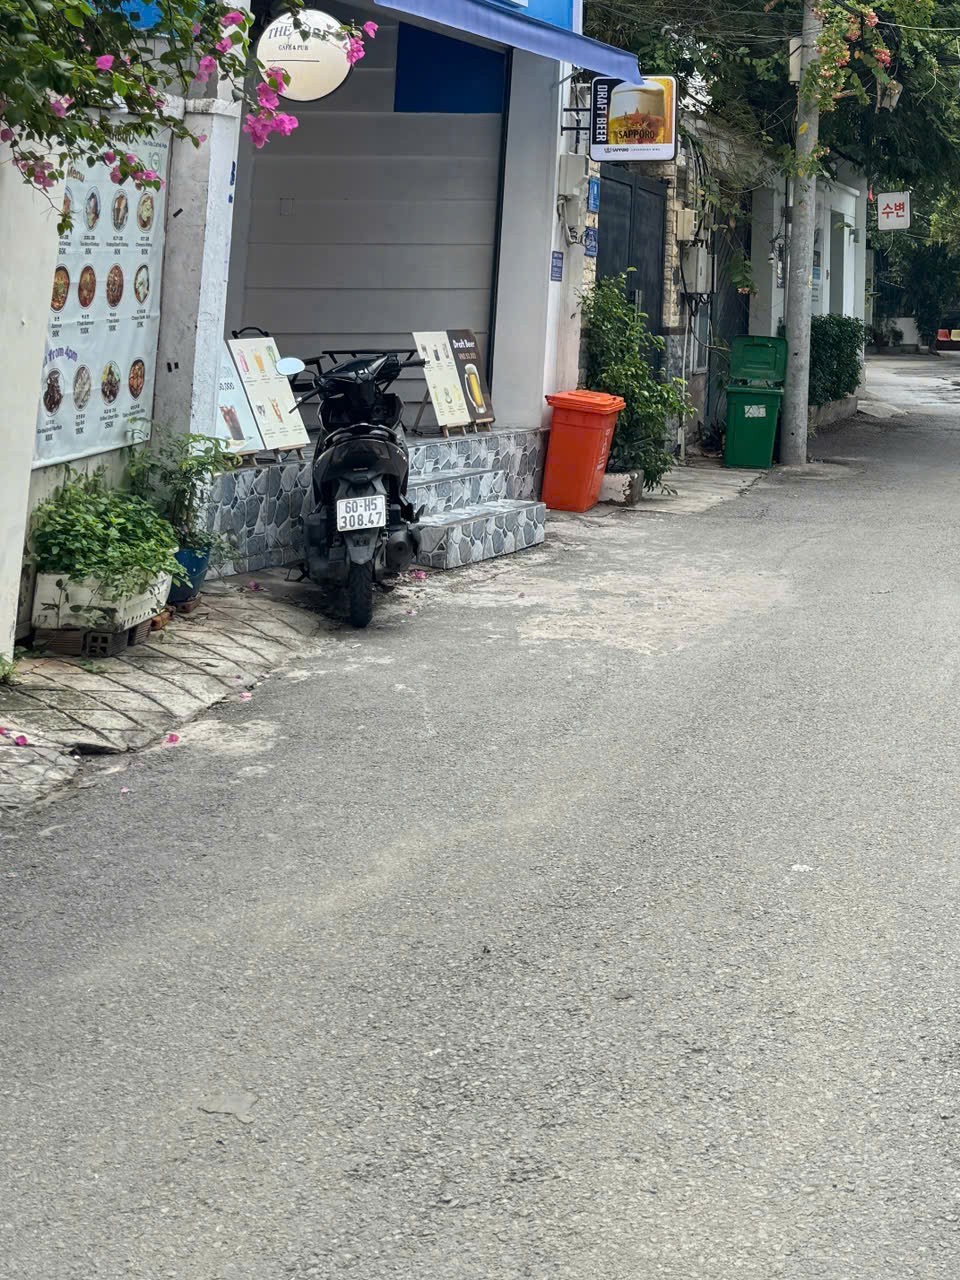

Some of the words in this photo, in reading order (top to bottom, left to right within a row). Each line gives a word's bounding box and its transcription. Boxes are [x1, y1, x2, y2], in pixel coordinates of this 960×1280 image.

[268, 25, 293, 40] THE
[596, 84, 609, 116] DRAFT
[595, 116, 608, 142] BEER
[618, 128, 655, 140] SAPPORO
[881, 201, 906, 219] 수변
[48, 346, 64, 362] from
[65, 345, 79, 362] 4pm
[341, 511, 383, 529] 308.47
